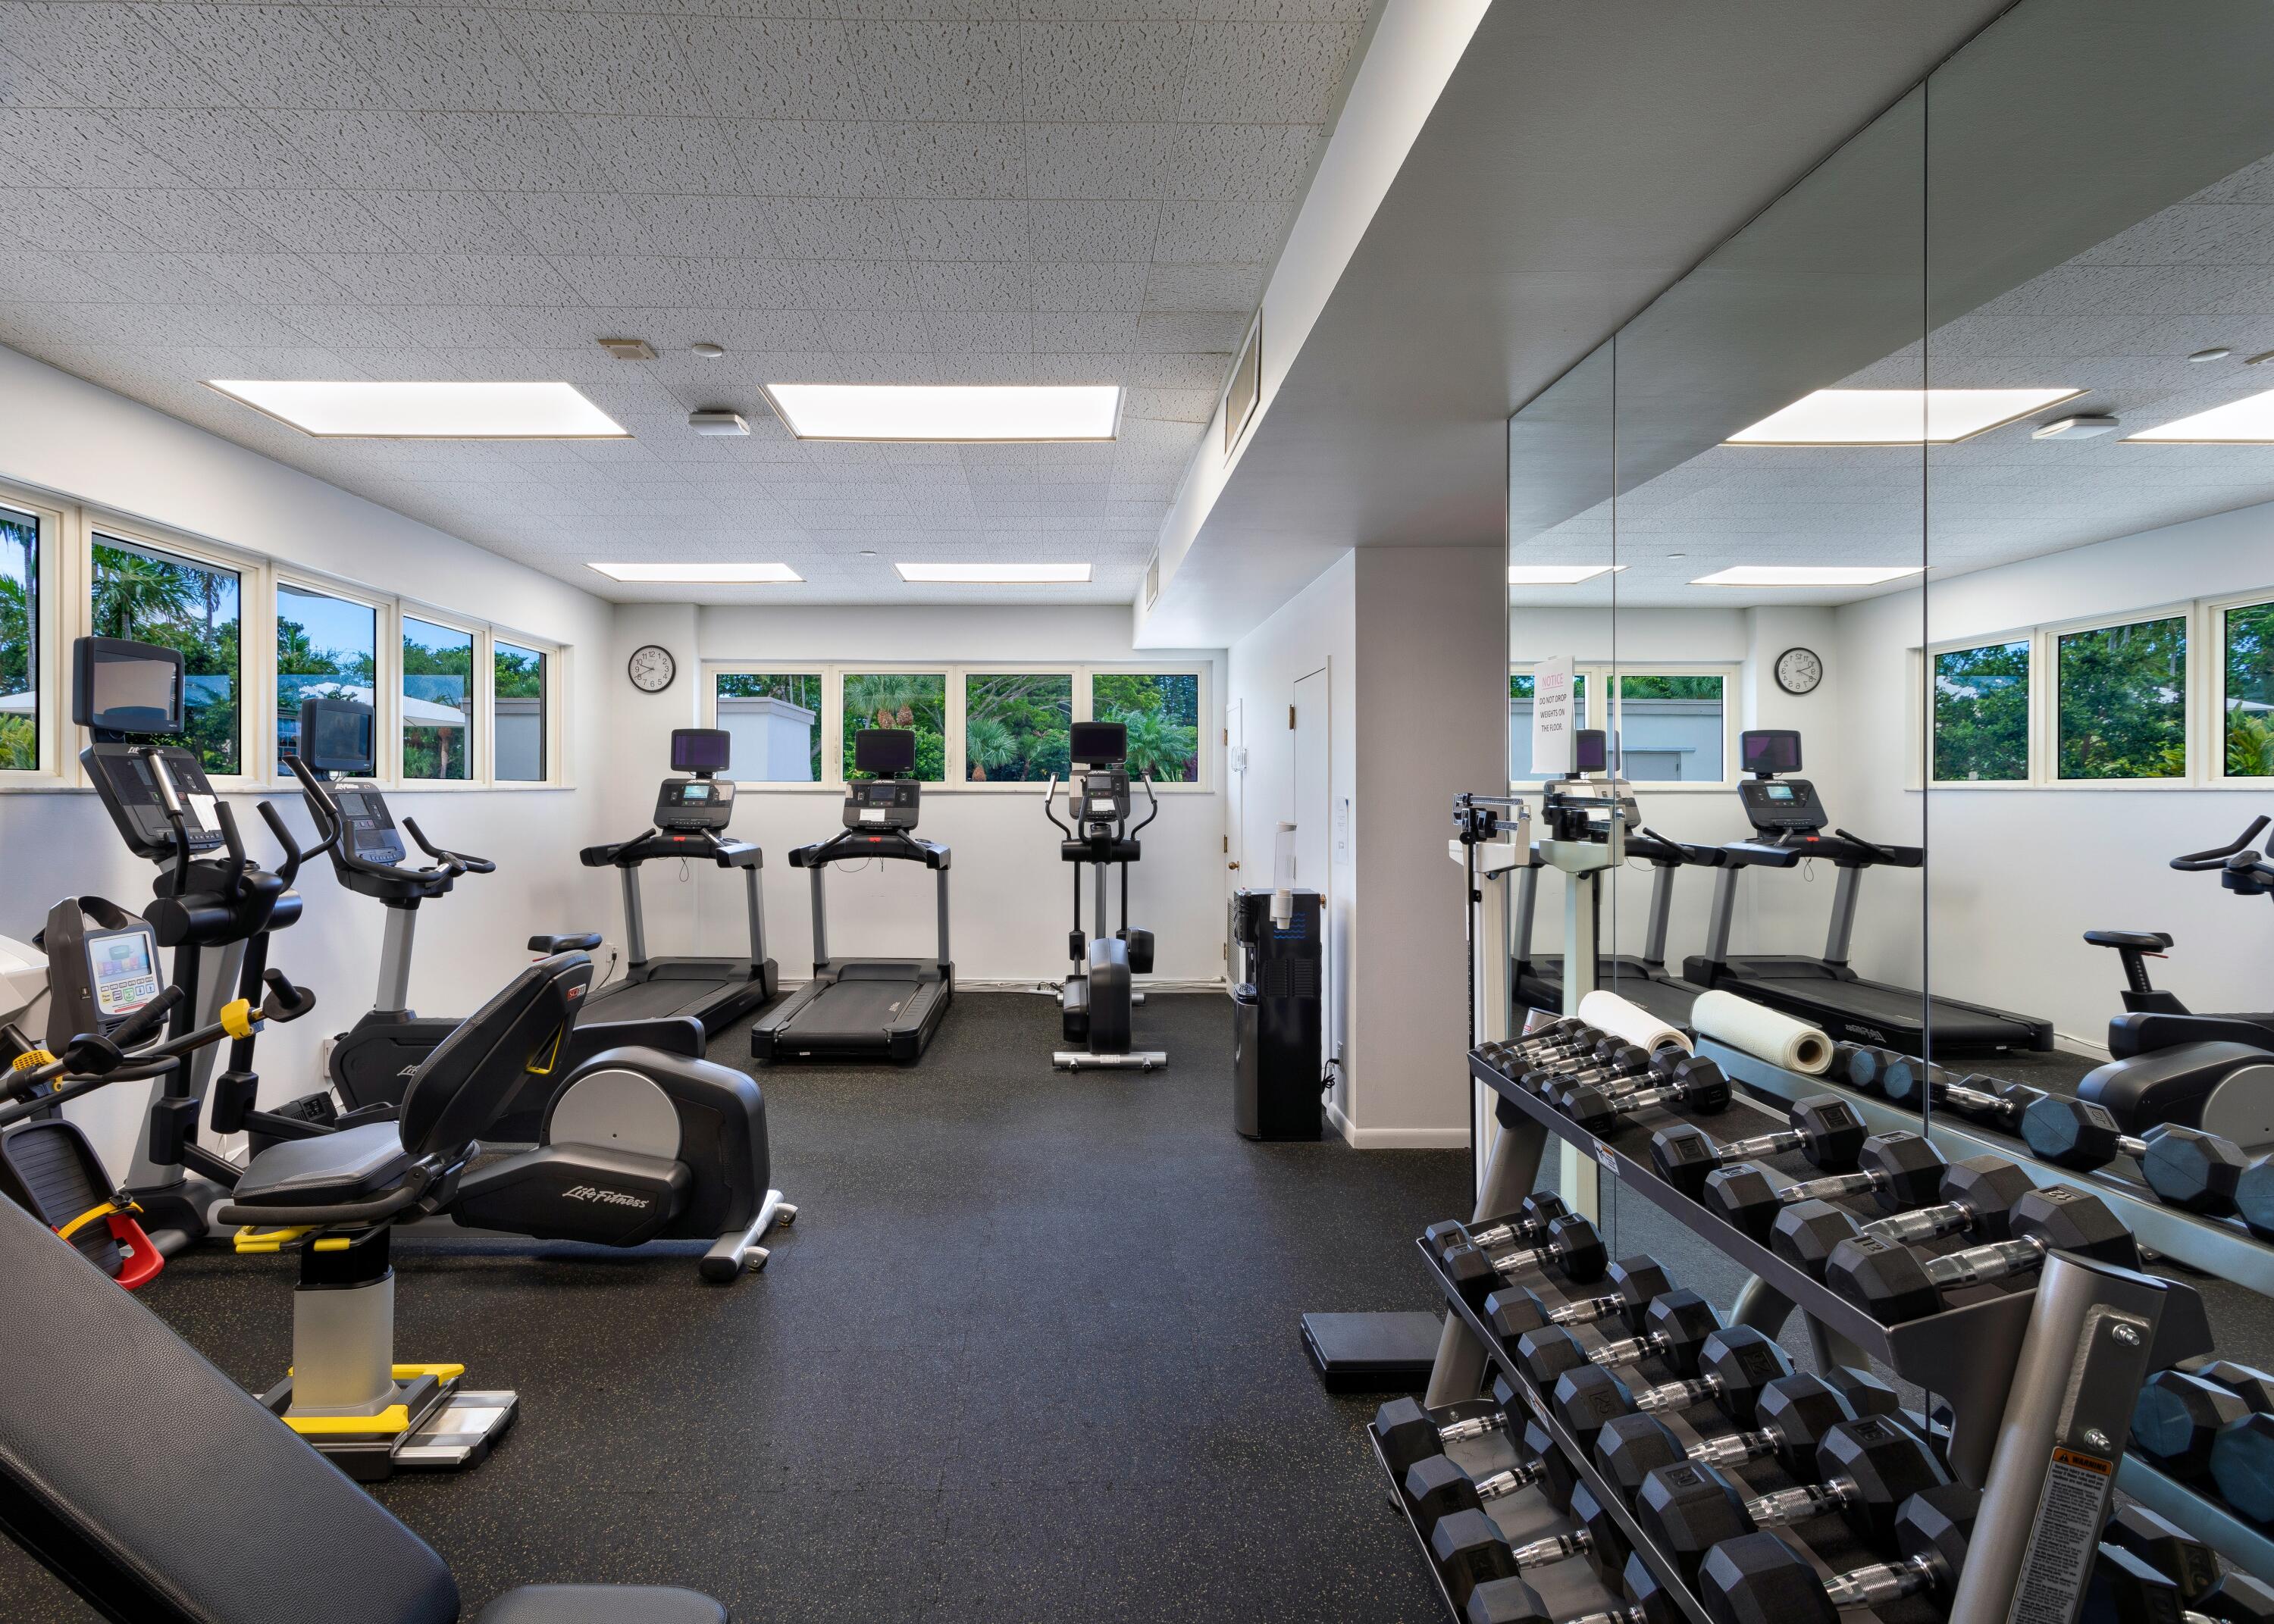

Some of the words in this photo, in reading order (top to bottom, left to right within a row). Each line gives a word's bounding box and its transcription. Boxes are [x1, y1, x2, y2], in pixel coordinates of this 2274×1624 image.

[1543, 673, 1563, 687] NOTICE
[1546, 696, 1555, 704] NOT
[1555, 694, 1567, 702] DROP
[1540, 709, 1558, 718] WEIGHTS
[396, 1064, 421, 1076] Lif
[562, 1185, 597, 1200] Life
[593, 1191, 646, 1208] Fitness
[2048, 1190, 2072, 1201] 12
[1862, 1241, 1884, 1252] 12
[2072, 1457, 2106, 1472] WARNING
